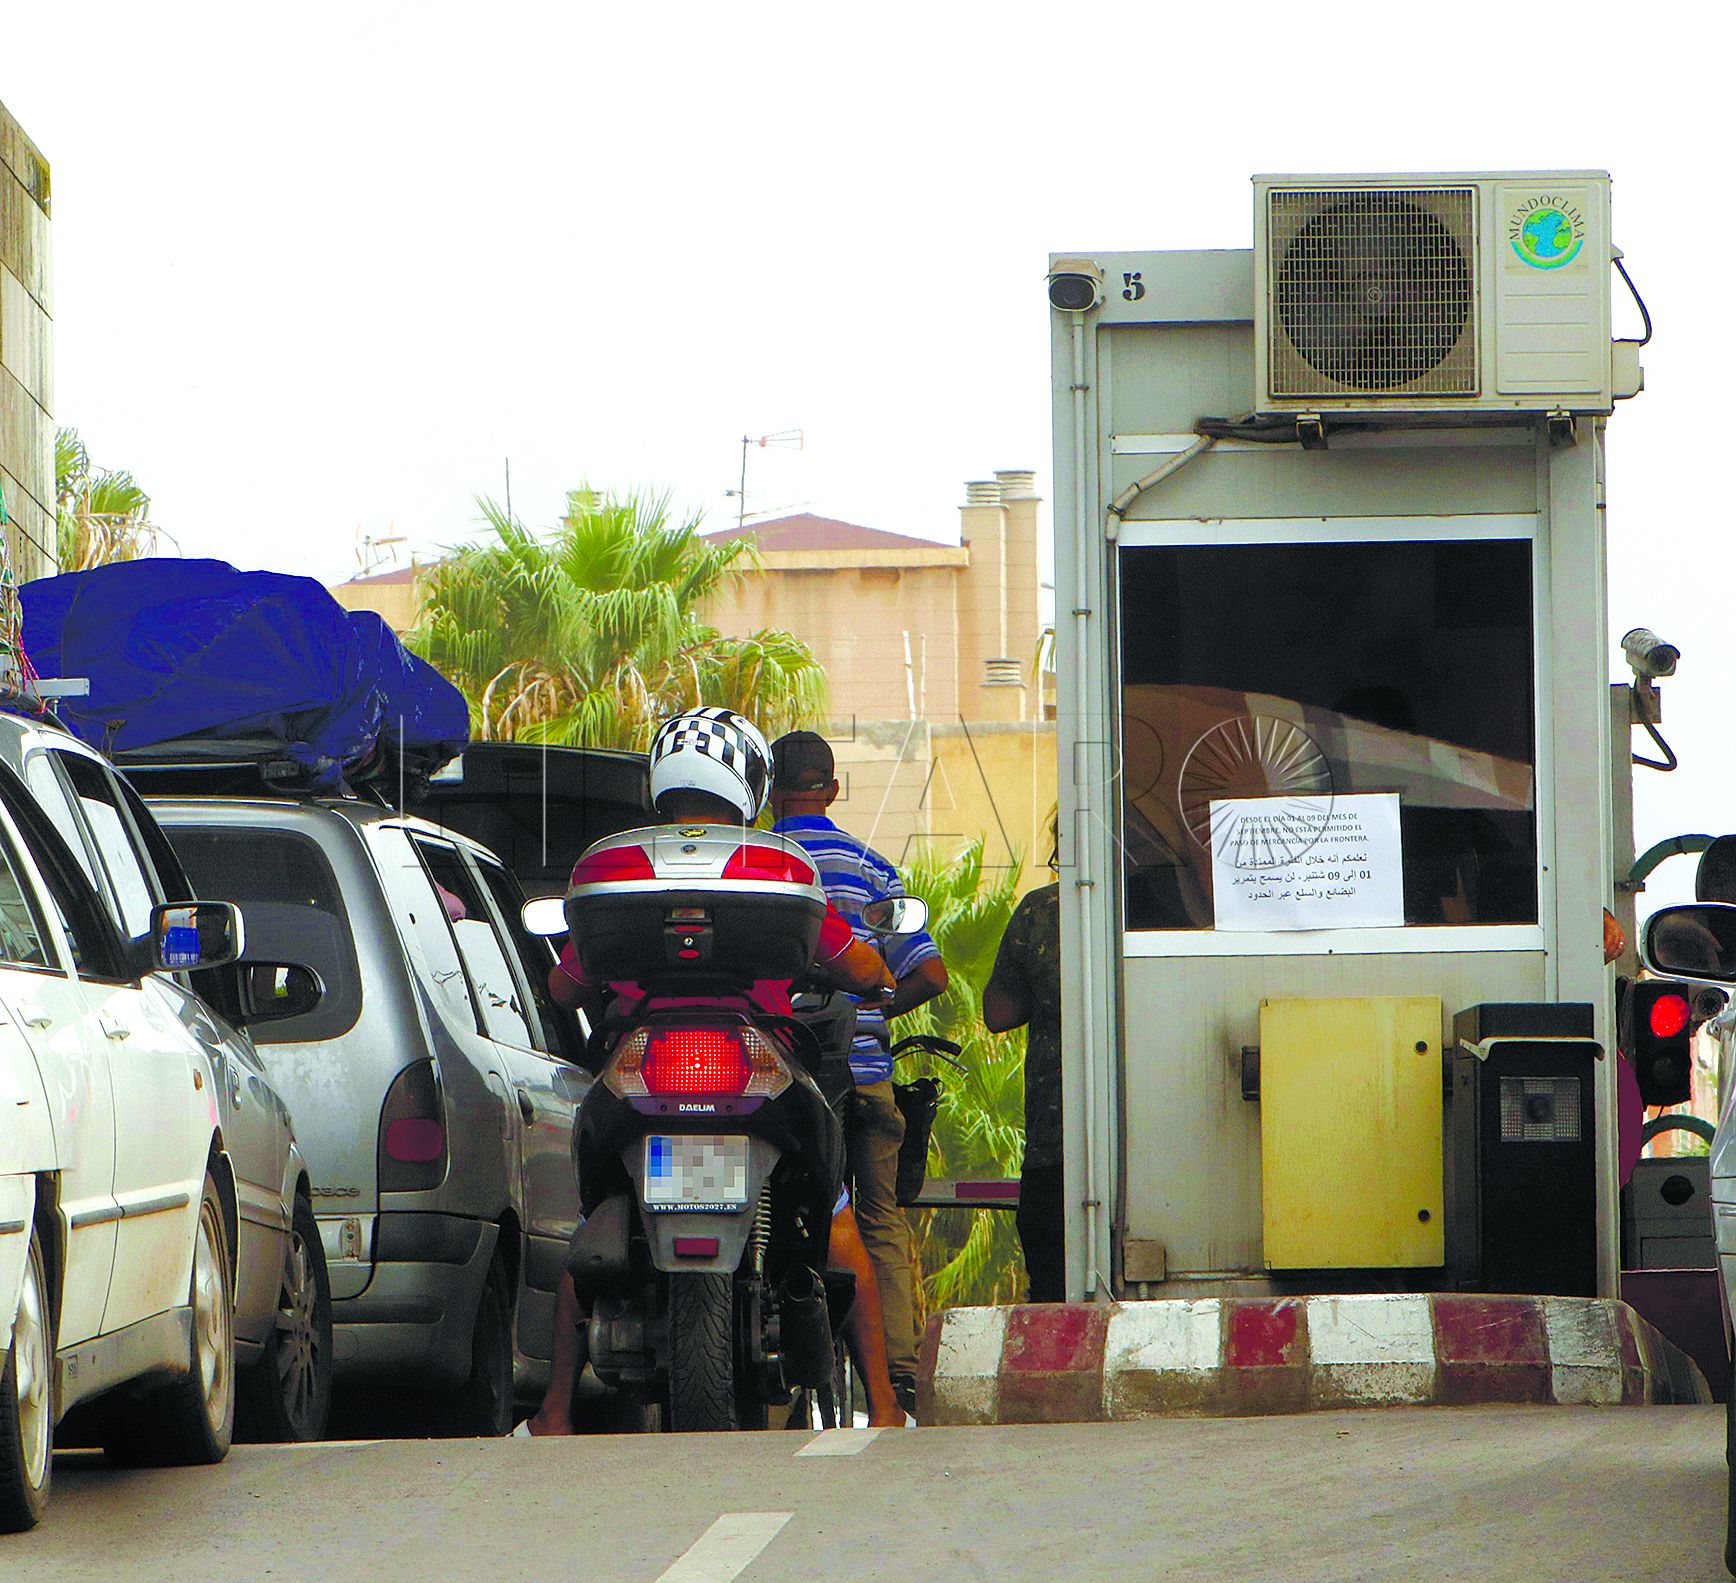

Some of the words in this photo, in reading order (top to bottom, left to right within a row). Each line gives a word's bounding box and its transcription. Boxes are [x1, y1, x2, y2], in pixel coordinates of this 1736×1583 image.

[1509, 195, 1584, 240] MUNDOCLIMA
[1122, 272, 1146, 301] 5
[1297, 814, 1305, 822] AL
[1307, 814, 1316, 822] 09
[1313, 824, 1353, 833] PERMITIDO
[1330, 835, 1369, 843] FRONTERA.
[1305, 855, 1324, 866] خلال
[1327, 871, 1340, 880] 09
[1359, 870, 1372, 880] 01
[1248, 889, 1274, 900] الحدود
[1279, 890, 1292, 900] عبر
[679, 1104, 715, 1112] DAELIM
[653, 1203, 737, 1211] WWW.MOTOS2027.ES
